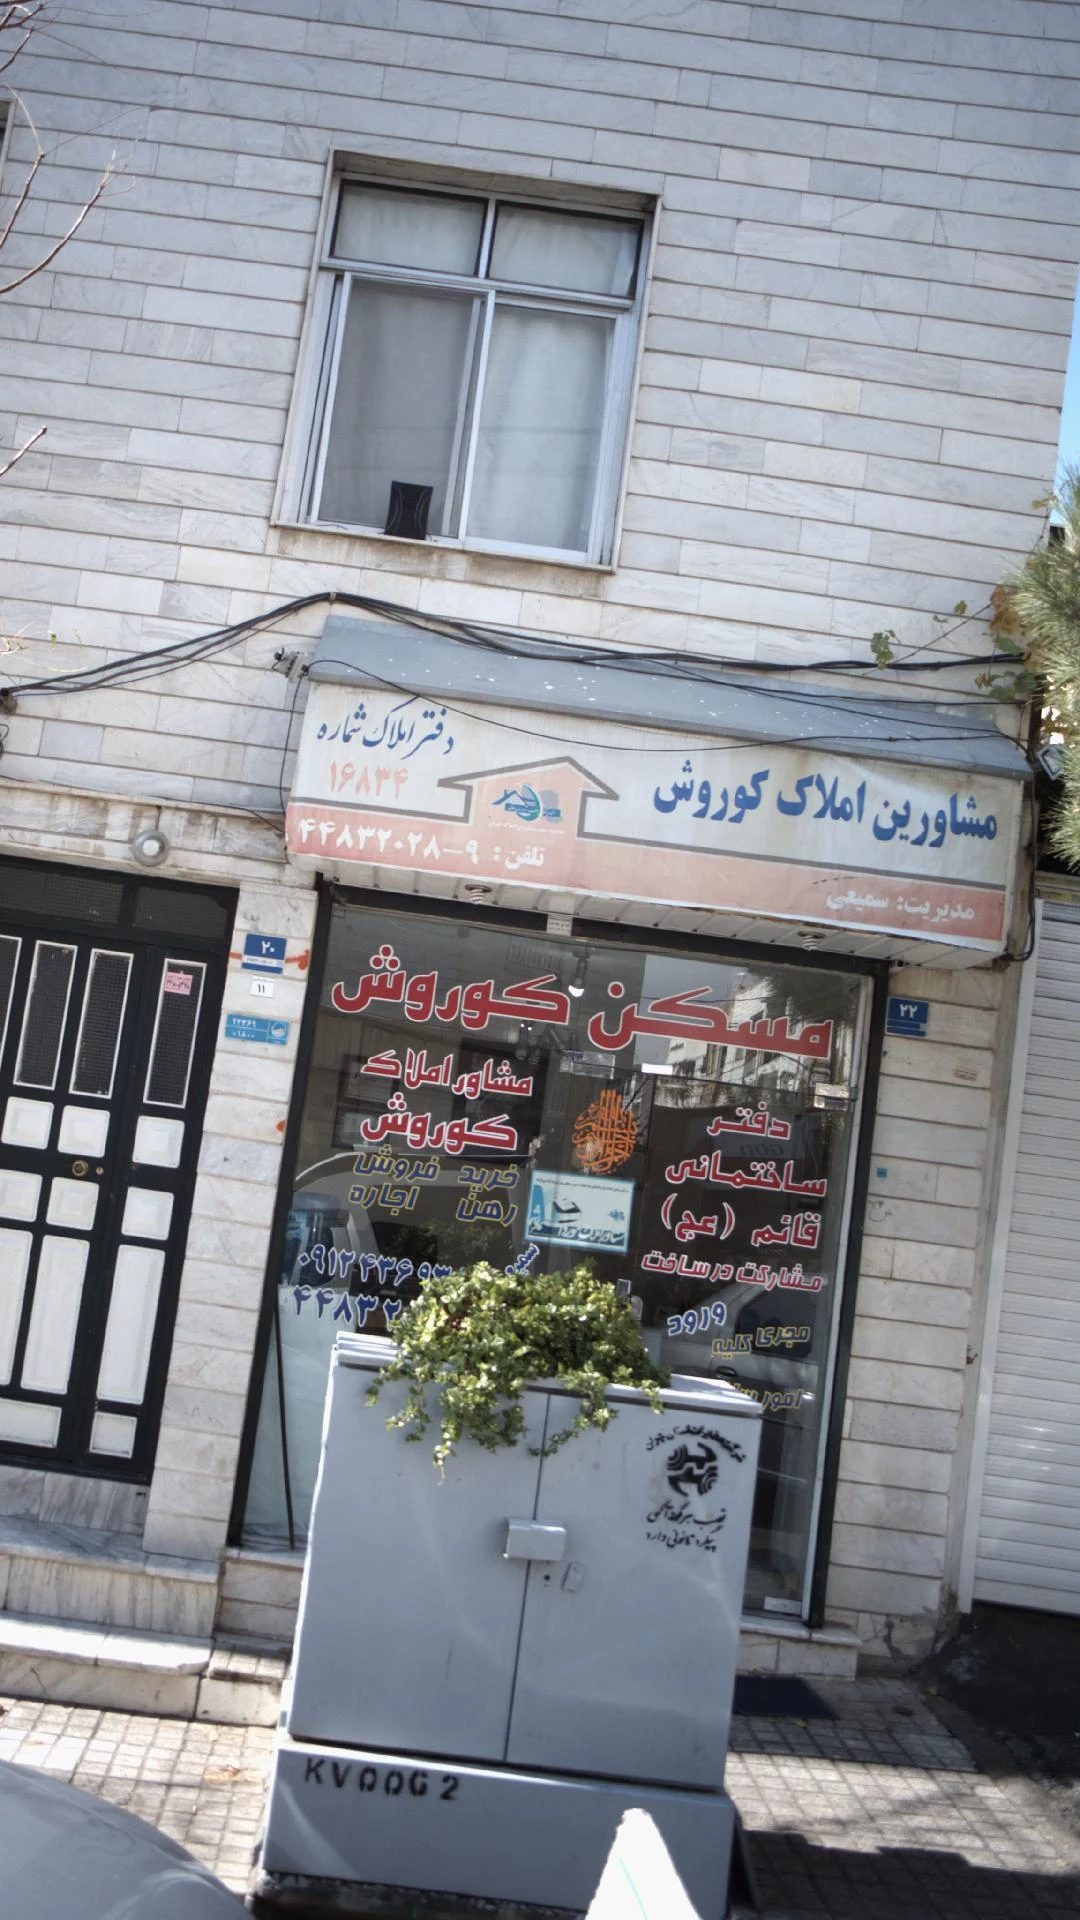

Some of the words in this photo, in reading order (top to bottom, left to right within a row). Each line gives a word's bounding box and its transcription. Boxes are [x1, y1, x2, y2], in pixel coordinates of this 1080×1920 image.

[316, 703, 366, 743] شماره
[362, 695, 420, 748] املاک
[401, 707, 455, 760] دفتر
[653, 759, 770, 824] کوروش
[777, 774, 867, 824] املاک
[872, 792, 998, 848] مشاورین
[826, 887, 889, 911] سمیعی
[261, 940, 275, 955] ۲۰
[331, 944, 571, 1031] کوروش
[586, 980, 835, 1060] مسکن
[899, 1003, 918, 1018] ۲۲
[360, 1047, 454, 1090] املاک
[451, 1058, 534, 1100] مشاور
[360, 1092, 518, 1155] کوروش
[706, 1101, 791, 1140] دفتر
[352, 1143, 440, 1182] فروش
[458, 1163, 521, 1192] خرید
[665, 1150, 828, 1198] ساختمانی
[347, 1183, 421, 1216] اجاره
[456, 1192, 520, 1227] رهن
[751, 1211, 822, 1249] قائم
[640, 1249, 711, 1280] ساخت
[709, 1262, 735, 1283] در
[735, 1262, 824, 1293] مشارکت
[666, 1301, 728, 1337] ورود
[756, 1326, 811, 1348] مجری
[711, 1334, 753, 1359] کلیه
